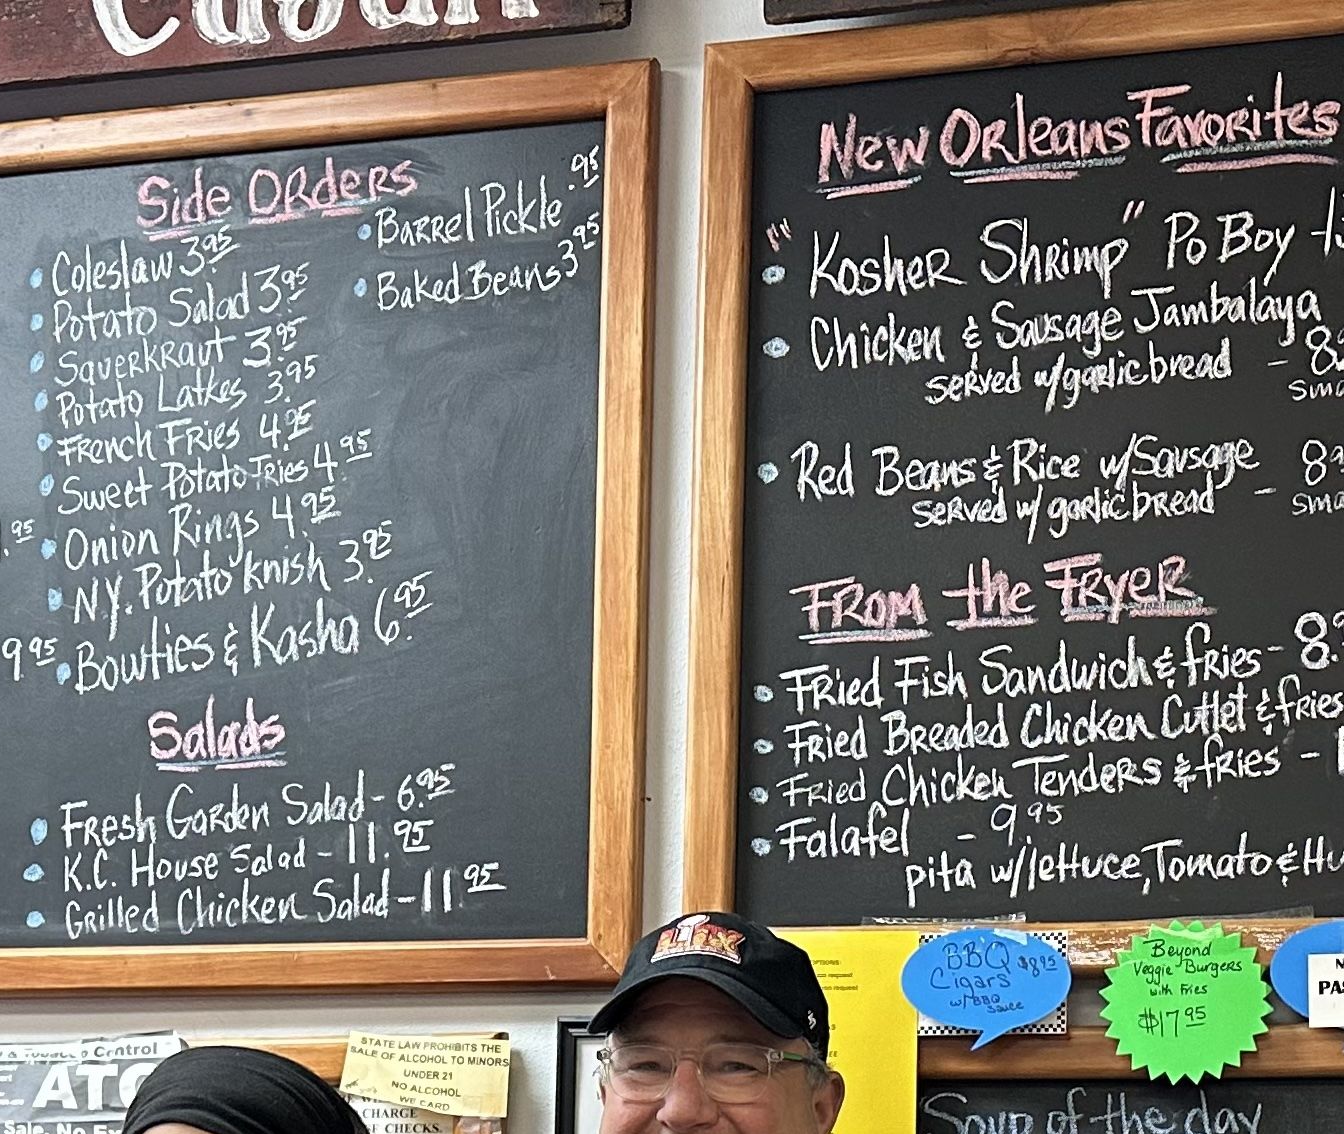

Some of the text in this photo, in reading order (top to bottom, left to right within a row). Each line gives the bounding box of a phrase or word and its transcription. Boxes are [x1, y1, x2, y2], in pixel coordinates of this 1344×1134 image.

[817, 115, 926, 185] New
[137, 167, 230, 229] Side
[485, 176, 562, 236] Pickle
[52, 244, 175, 297] Coleslaw
[1164, 211, 1295, 285] Po Boy
[378, 264, 459, 310] Baked
[52, 280, 251, 343] Potato Salad
[809, 276, 1321, 371] Chicken Sausage Jambalaya
[790, 439, 1080, 504] Red Beans Rice
[63, 502, 259, 570] Onion Rings
[981, 634, 1150, 702] Sandwich
[148, 695, 285, 760] Salads
[780, 809, 911, 860] Falafel
[130, 855, 219, 889] House
[943, 941, 1009, 971] BBQ
[1134, 960, 1242, 978] Veggie Burgers
[1144, 939, 1212, 968] Beyond
[930, 968, 1012, 991] Cigars
[1150, 984, 1208, 997] with Fries
[351, 1046, 378, 1057] SALE
[399, 1054, 447, 1064] ALCOHOL
[451, 1056, 464, 1065] TO
[467, 1058, 509, 1067] MINORS
[361, 1037, 501, 1053] STATE LAW PROHIBITS THE
[391, 1081, 461, 1097] NO ALCOHOL
[404, 1069, 453, 1080] UNDER 21
[363, 1108, 417, 1119] CHARGE
[420, 1100, 450, 1111] CARD
